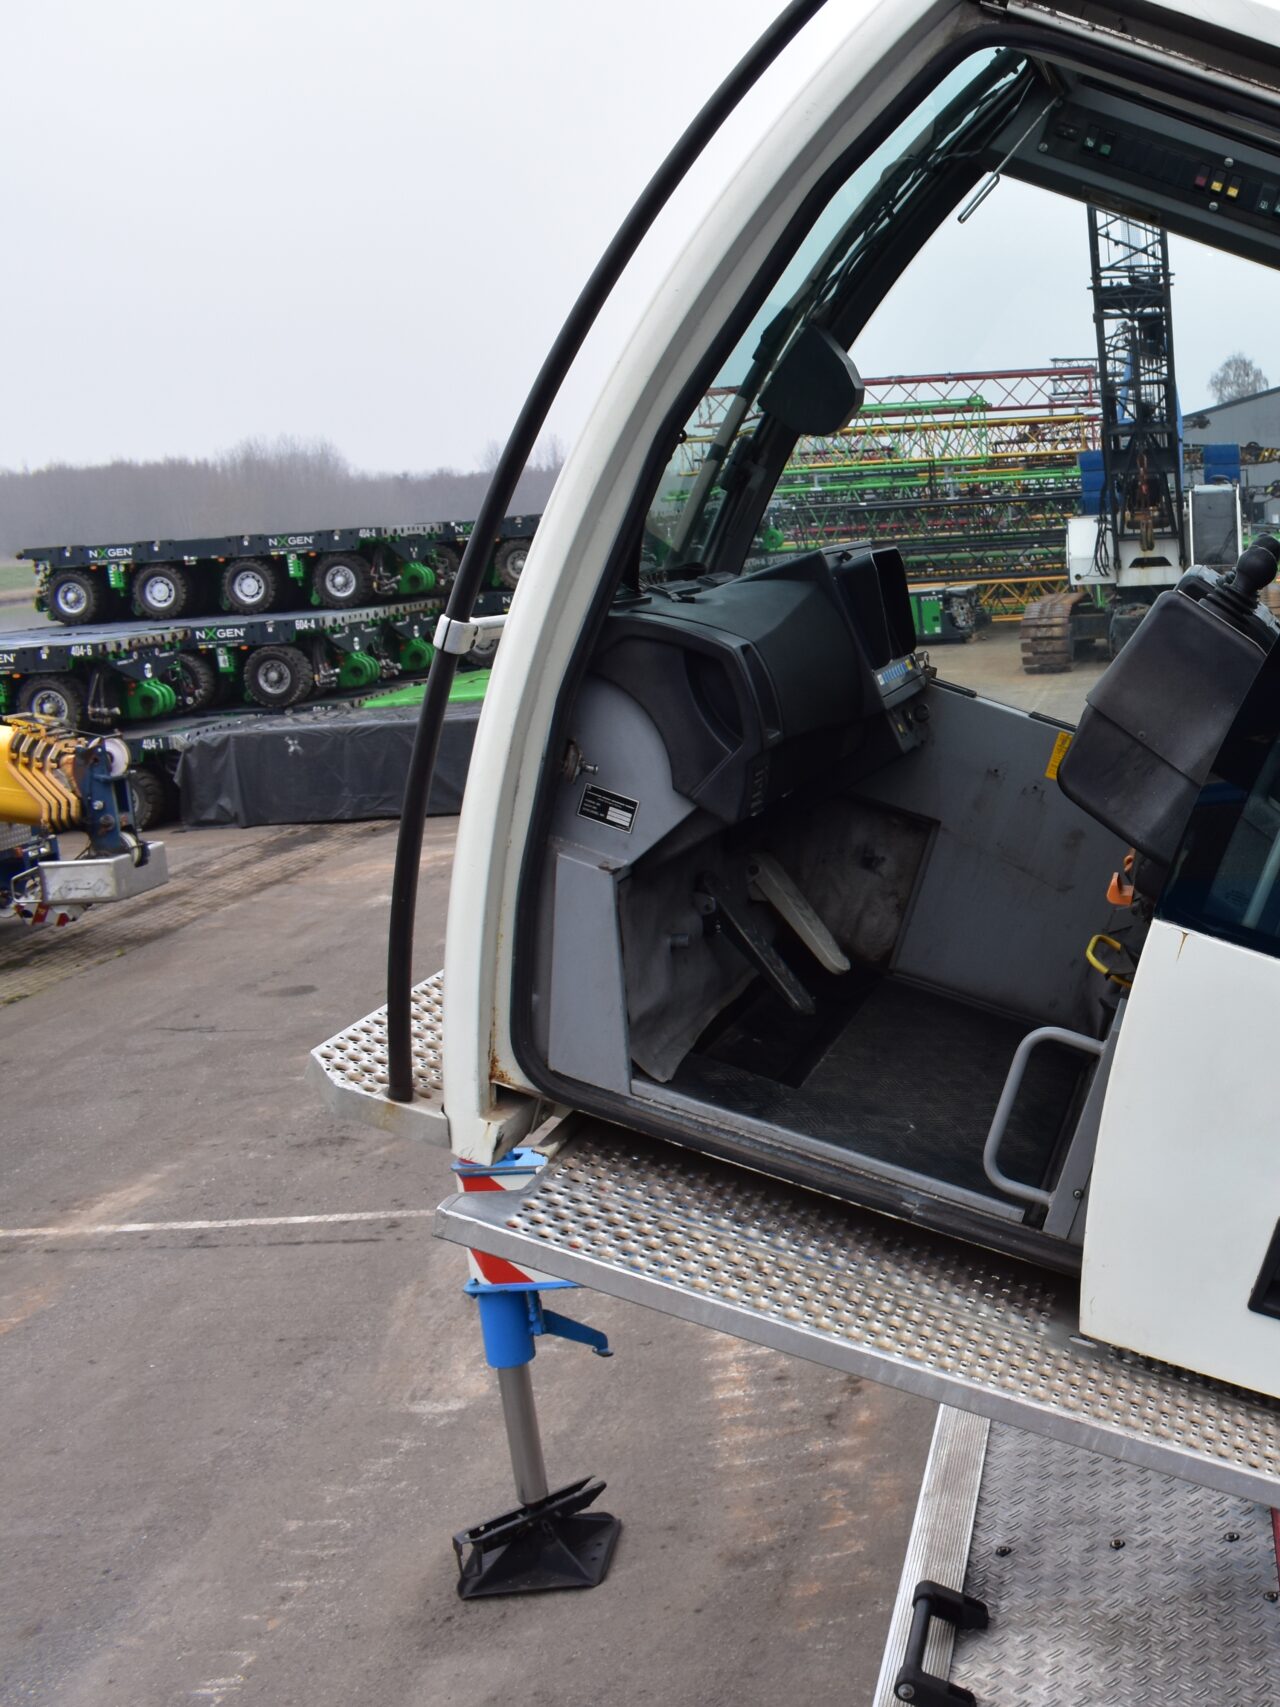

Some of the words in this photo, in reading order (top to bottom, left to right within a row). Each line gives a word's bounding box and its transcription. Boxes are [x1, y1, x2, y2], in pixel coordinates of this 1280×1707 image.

[268, 535, 313, 547] NXGEN
[88, 547, 132, 559] NXGEN
[295, 619, 316, 630] 604-4
[195, 627, 245, 640] NXGEN
[70, 644, 93, 656] 404-6
[142, 737, 164, 750] 404-1
